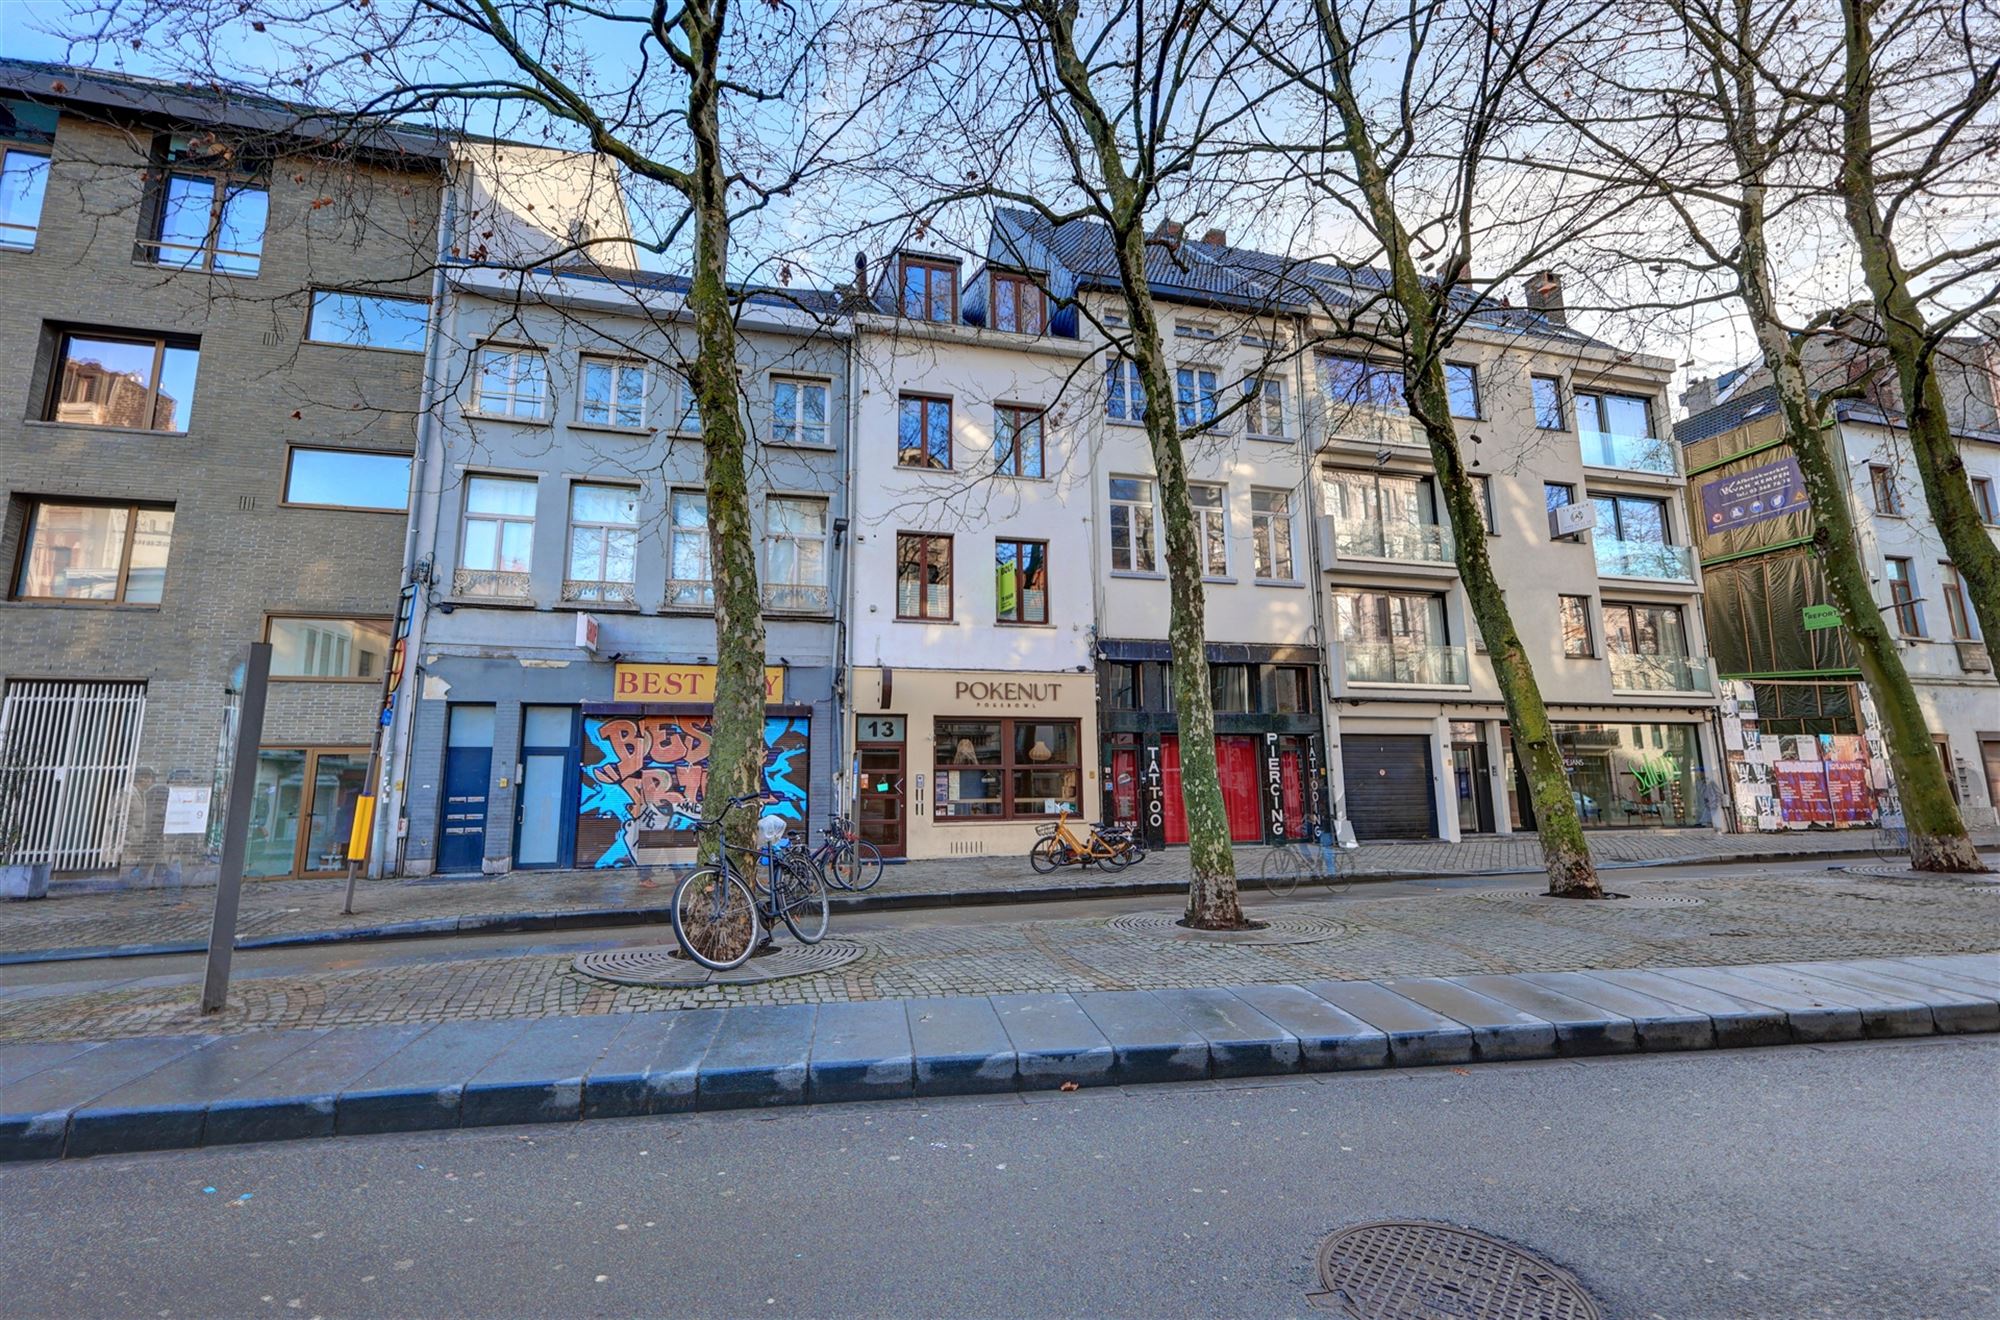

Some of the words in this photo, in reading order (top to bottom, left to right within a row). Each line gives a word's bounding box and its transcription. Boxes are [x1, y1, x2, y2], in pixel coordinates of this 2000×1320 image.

[1733, 482, 1751, 492] VAN
[1754, 471, 1790, 486] KEMPEN
[617, 671, 705, 695] BEST
[956, 681, 1062, 701] POKENUT
[868, 721, 894, 737] 13
[1147, 746, 1162, 827] TATTOO
[1267, 733, 1283, 835] PIERCING
[1308, 736, 1321, 837] TATTOOING
